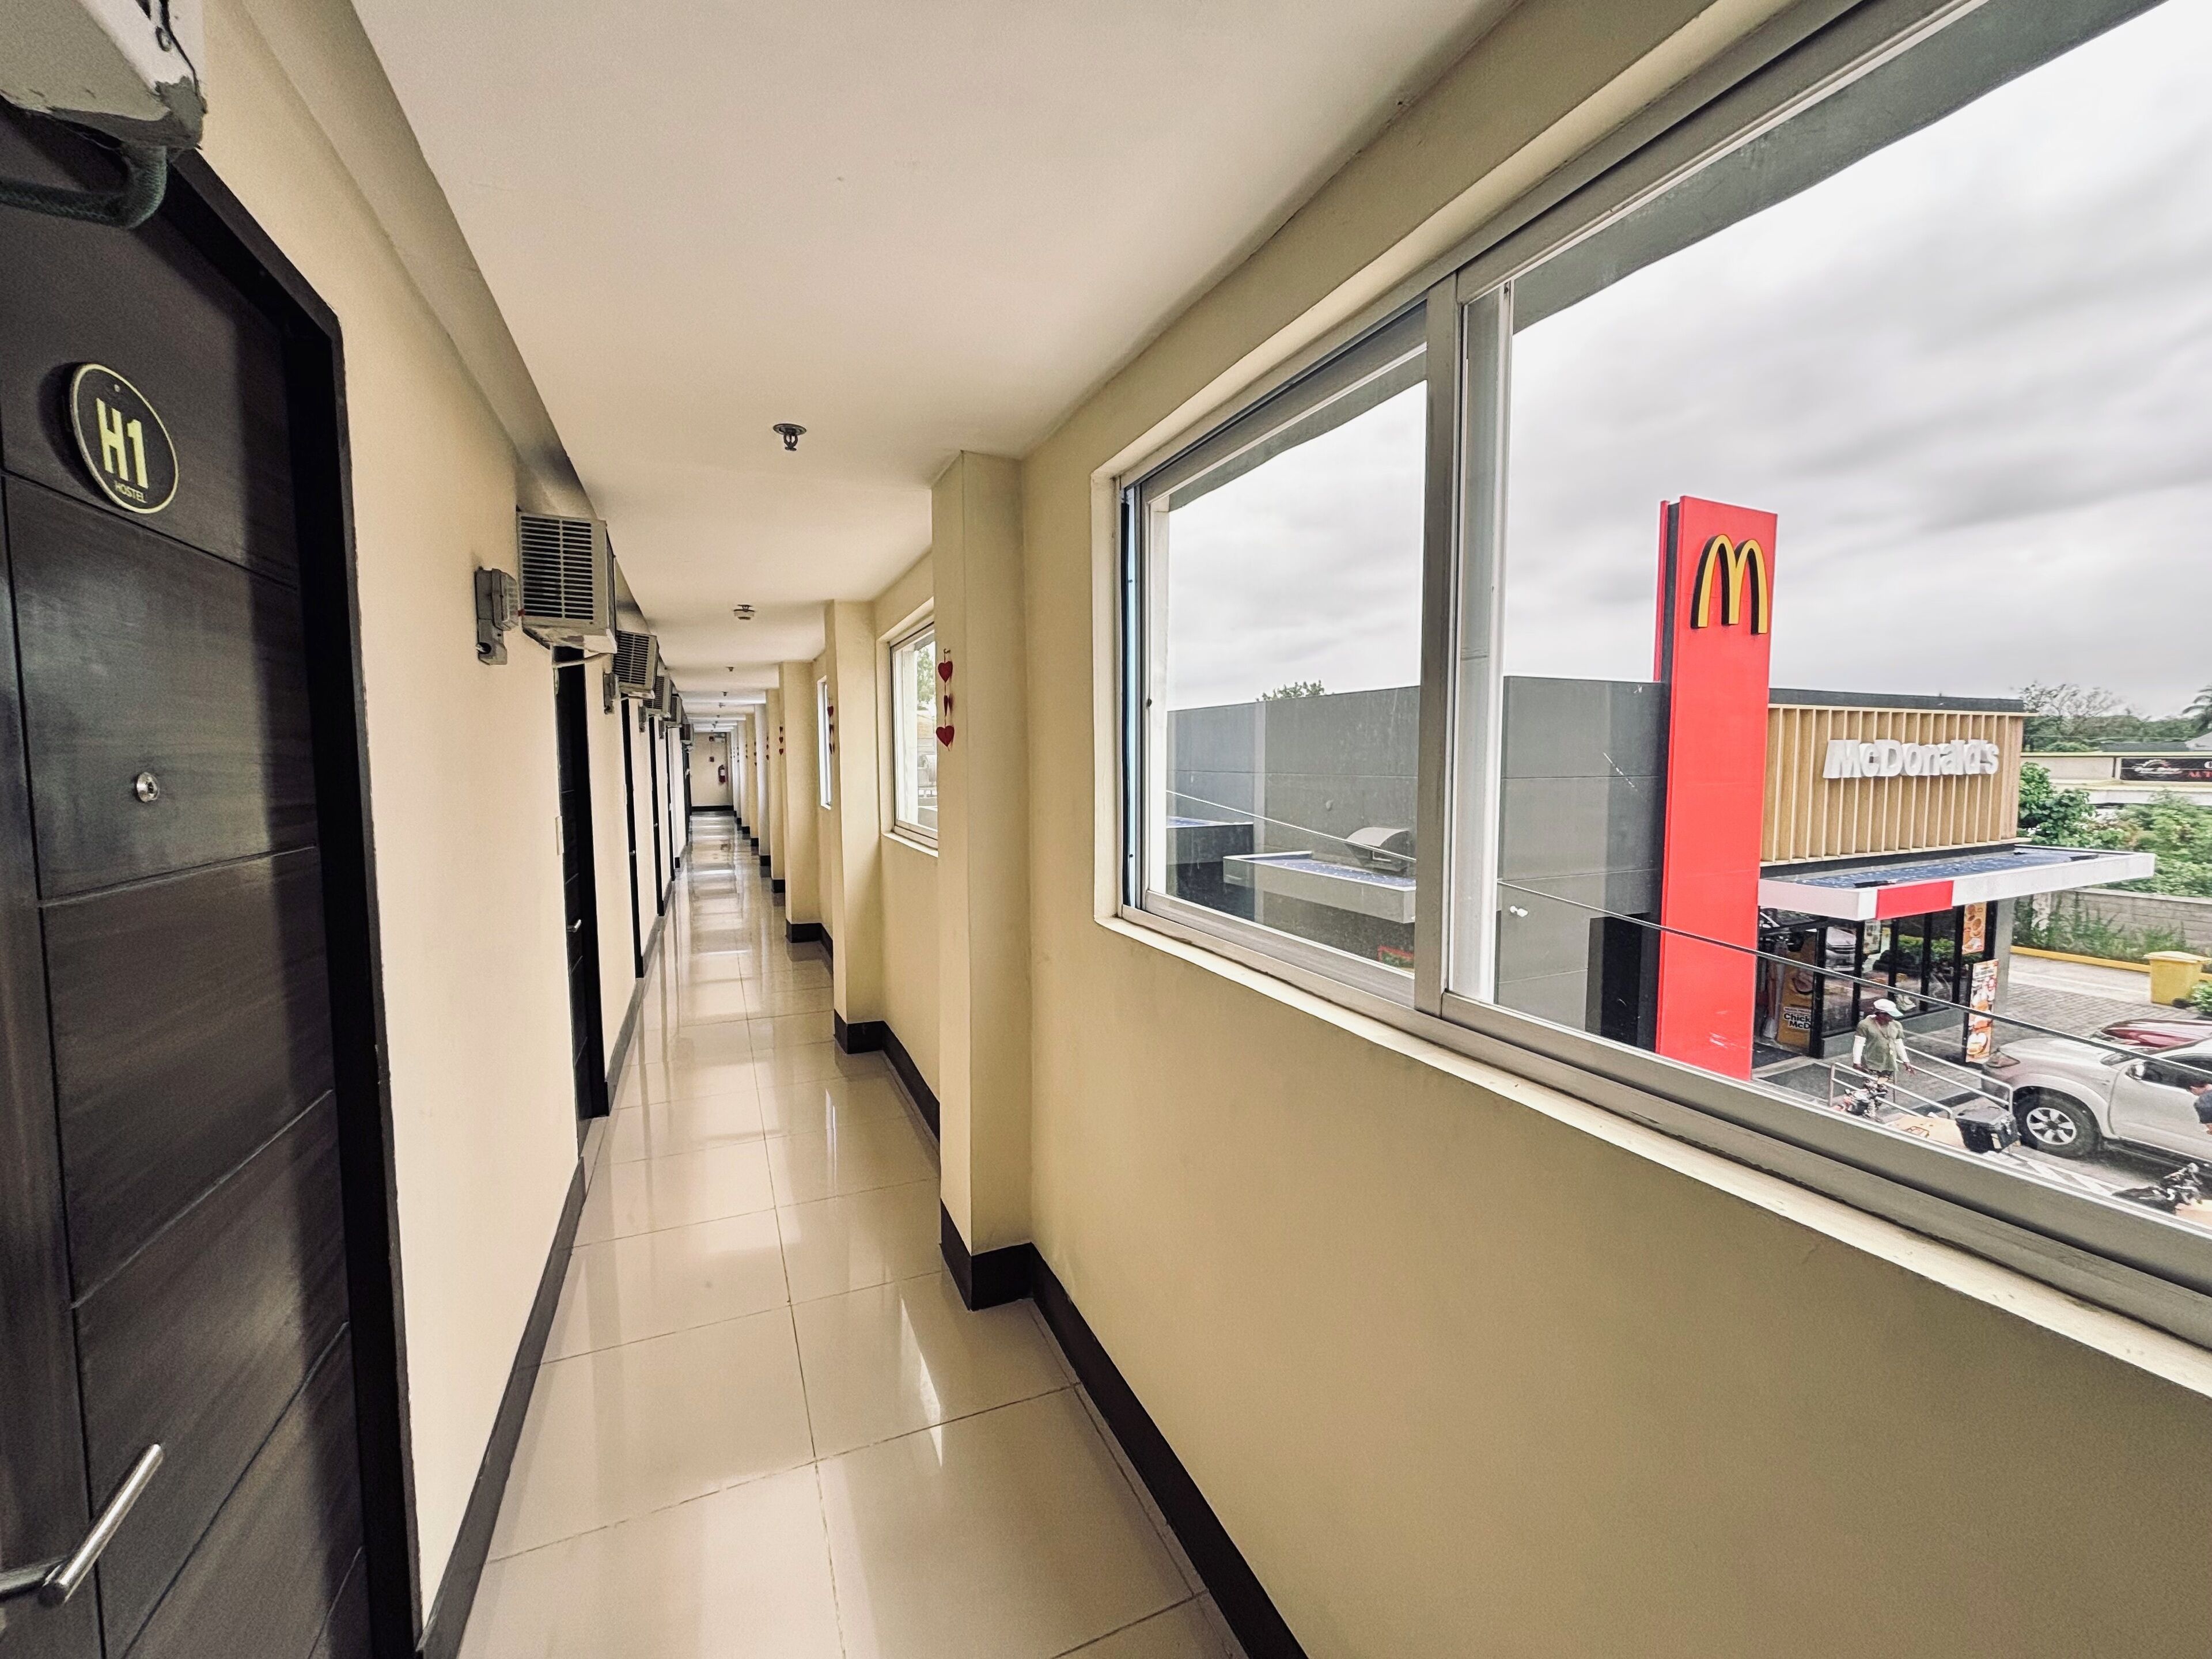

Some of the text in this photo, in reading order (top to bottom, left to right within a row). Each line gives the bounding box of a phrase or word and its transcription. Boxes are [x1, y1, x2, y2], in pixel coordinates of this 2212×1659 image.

[96, 397, 149, 489] H1
[114, 480, 147, 503] HOSTEL
[1823, 739, 1999, 779] McDonald's
